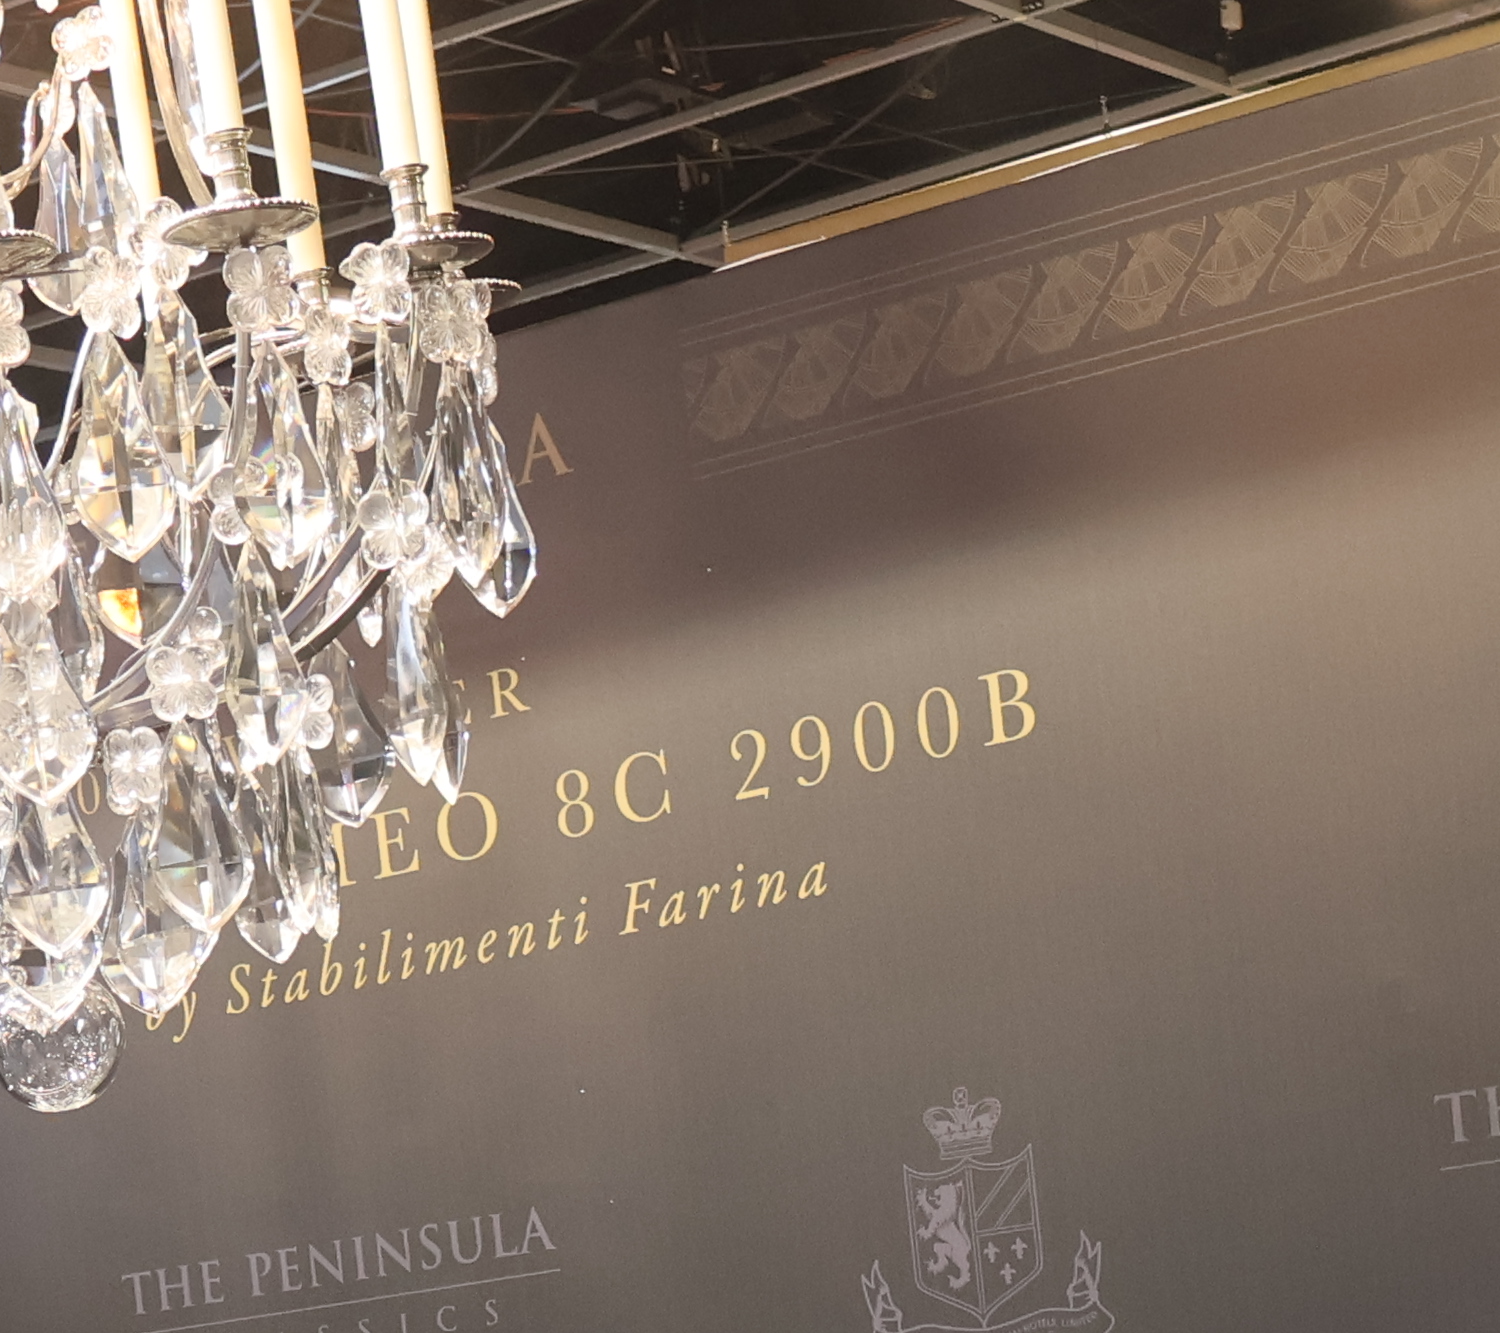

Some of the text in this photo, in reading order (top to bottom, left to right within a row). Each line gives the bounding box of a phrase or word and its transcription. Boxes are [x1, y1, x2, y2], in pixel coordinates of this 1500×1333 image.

[555, 747, 674, 839] 8C
[728, 667, 1038, 802] 2900B
[226, 895, 590, 1015] Stabilimenti
[619, 859, 829, 936] Farina
[121, 1205, 557, 1316] THE PENINSULA
